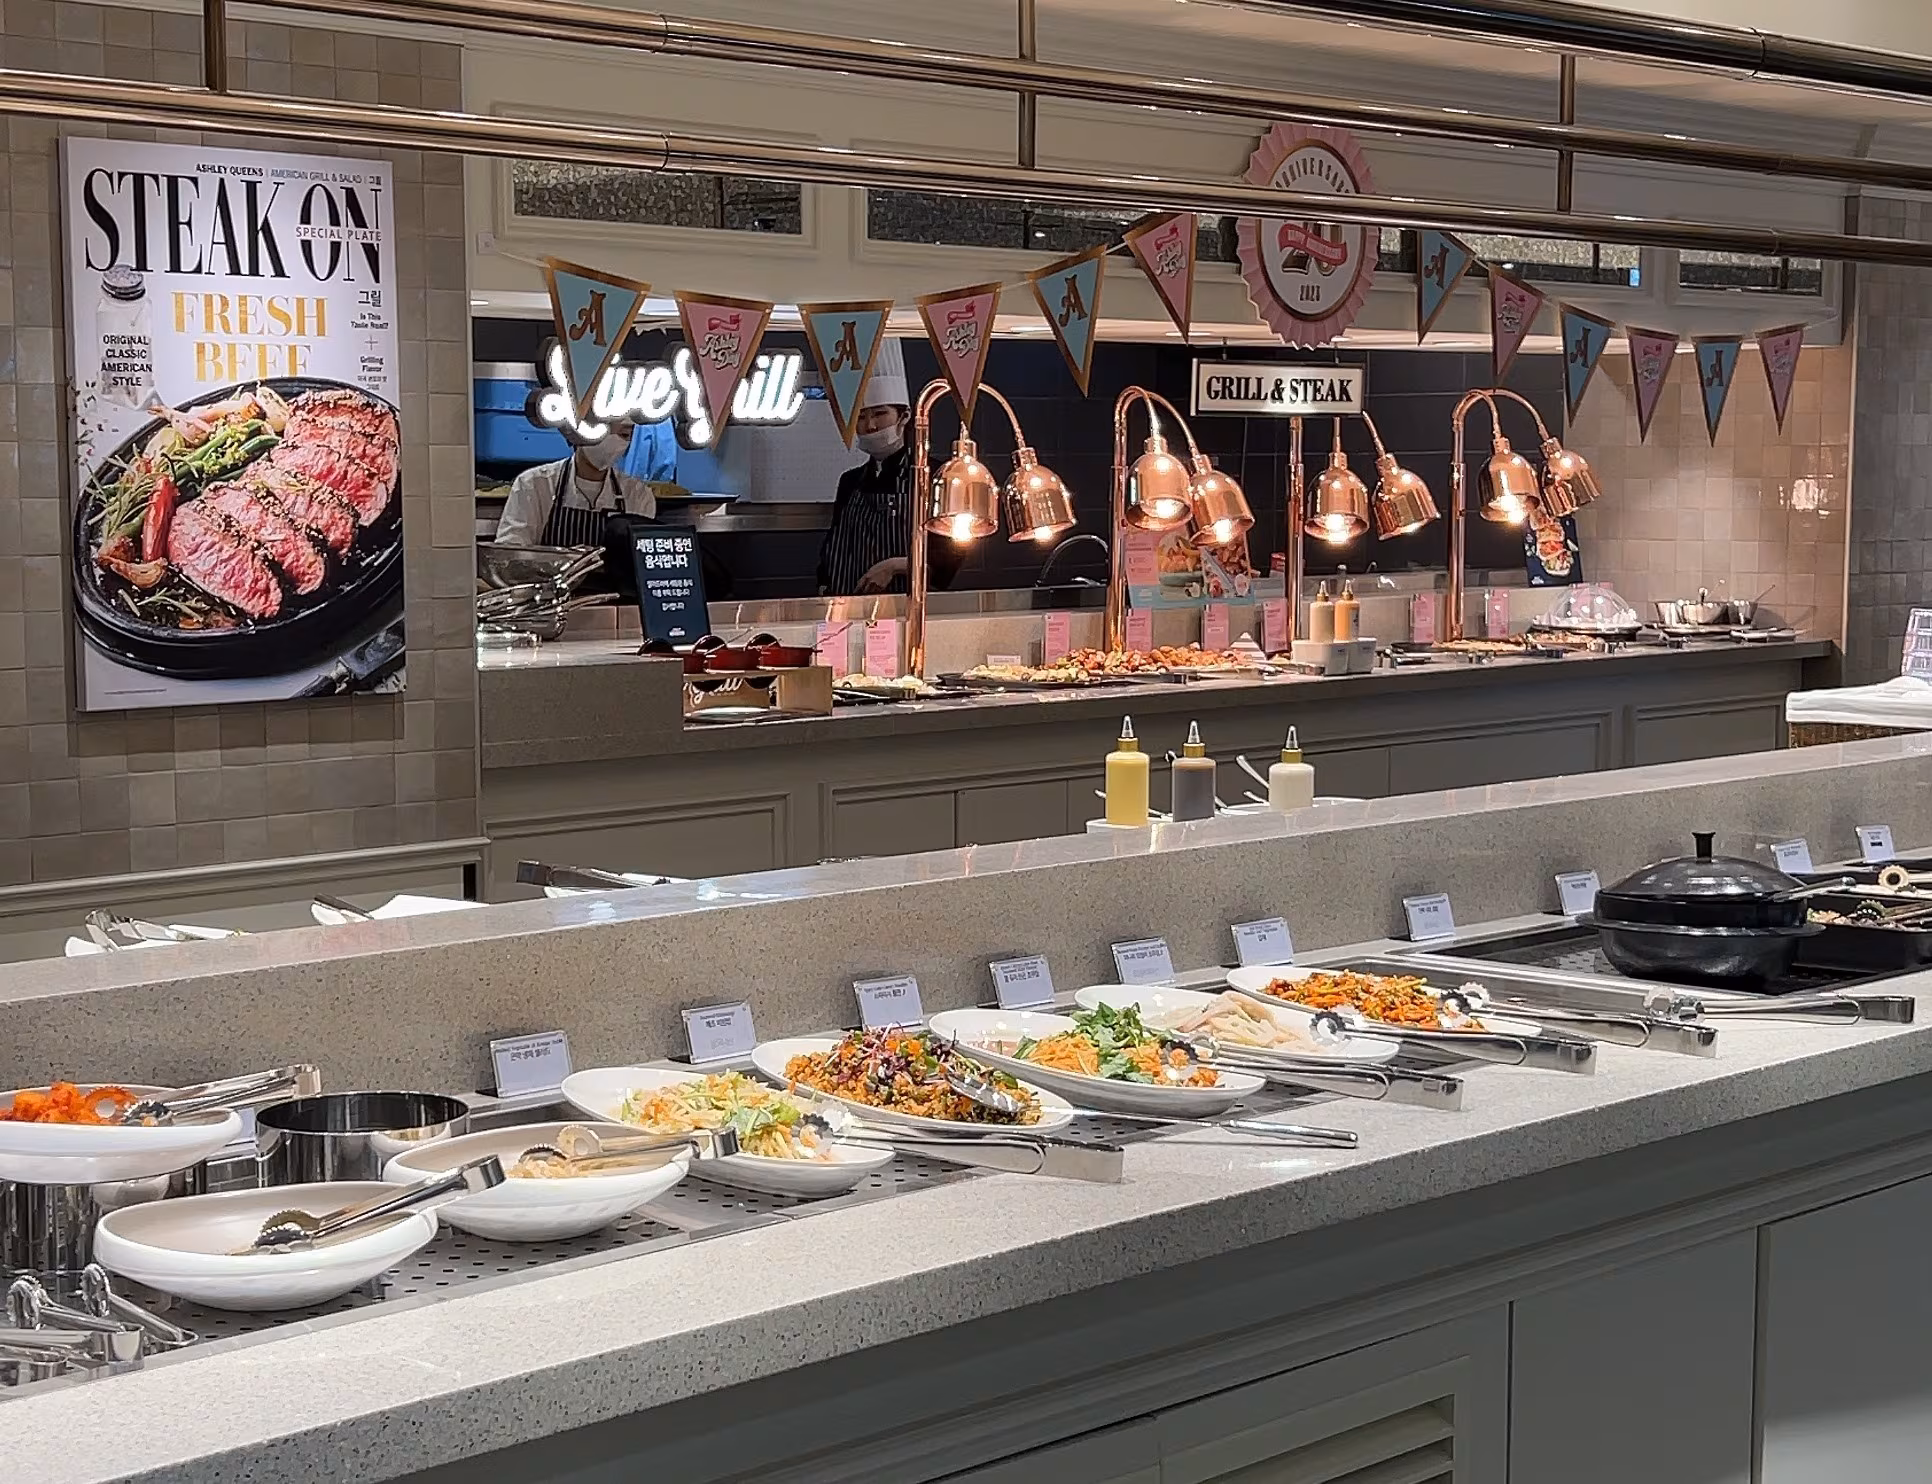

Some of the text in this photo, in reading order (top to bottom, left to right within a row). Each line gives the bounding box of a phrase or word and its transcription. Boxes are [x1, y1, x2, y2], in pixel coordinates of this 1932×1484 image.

[195, 163, 228, 175] ASHLEY
[230, 166, 264, 177] QUEENS
[1275, 157, 1350, 194] ANNIVERSAR
[84, 168, 382, 284] STEAK ON
[296, 226, 382, 241] SPECIAL PLATE
[358, 290, 382, 308] 그릴
[171, 291, 329, 338] FRESH
[569, 289, 607, 346] A
[102, 334, 149, 346] ORIGINAL
[830, 320, 863, 373] A
[105, 348, 147, 360] CLASSIC
[193, 341, 312, 383] BEEF
[101, 361, 153, 373] AMERICAN
[112, 376, 142, 387] STYLE
[1206, 375, 1353, 404] GRILL & STEAK
[645, 553, 688, 569] 음식입니다
